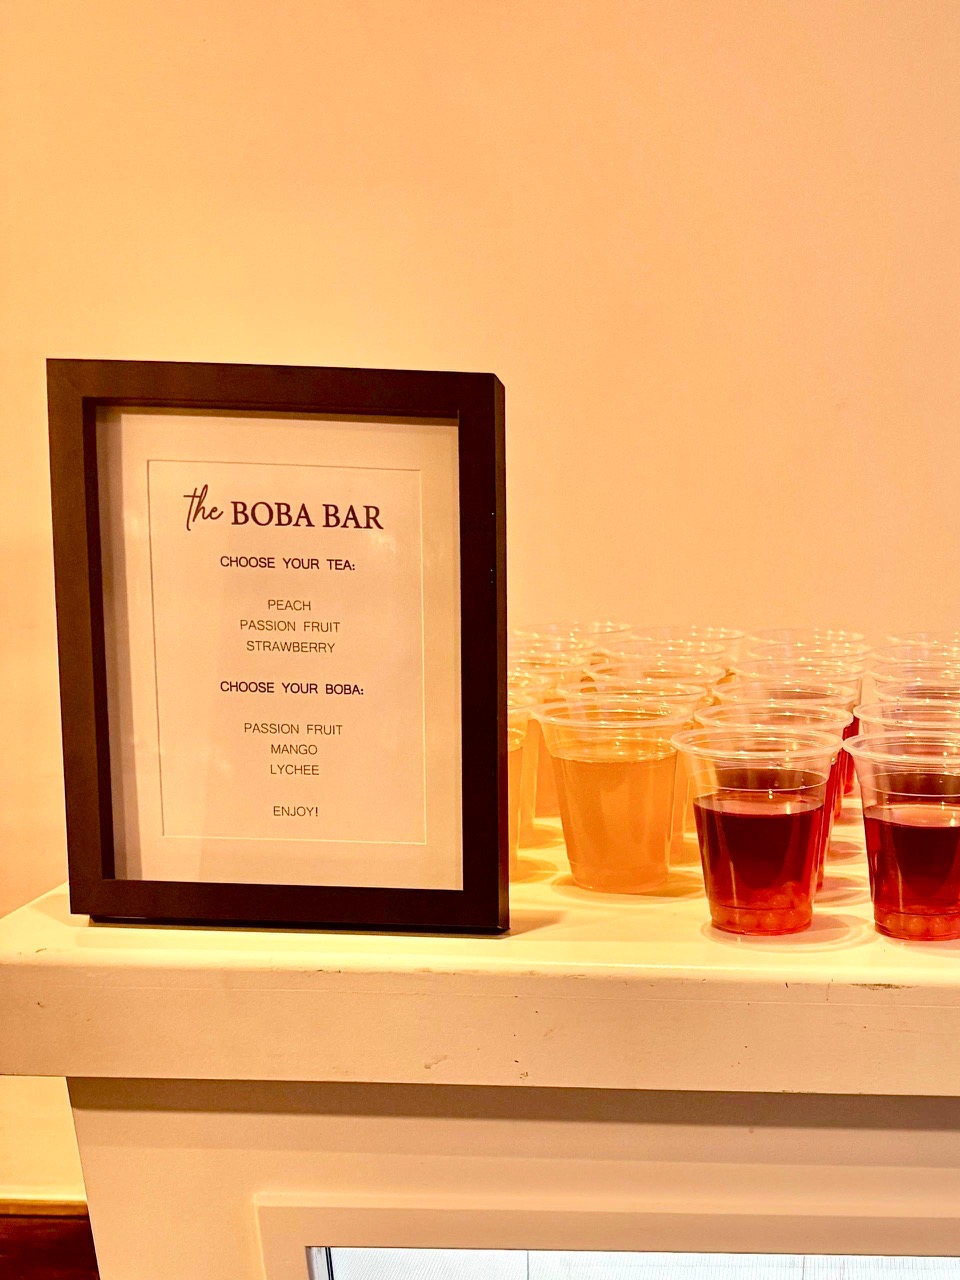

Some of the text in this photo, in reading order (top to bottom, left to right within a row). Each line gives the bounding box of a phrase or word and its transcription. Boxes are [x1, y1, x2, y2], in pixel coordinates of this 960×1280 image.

[183, 484, 384, 531] the BOBA BAR
[220, 556, 356, 571] CHOOSE YOUR TEA:
[267, 599, 312, 611] PEACH
[240, 619, 341, 633] PASSION FRUIT
[246, 640, 335, 653] STRAWBERRY
[220, 681, 364, 696] CHOOSE YOUR BOBA:
[244, 722, 343, 736] PASSION FRUIT
[270, 744, 318, 756] MANGO
[270, 764, 320, 776] LYCHEE
[273, 805, 319, 817] ENJOY!
